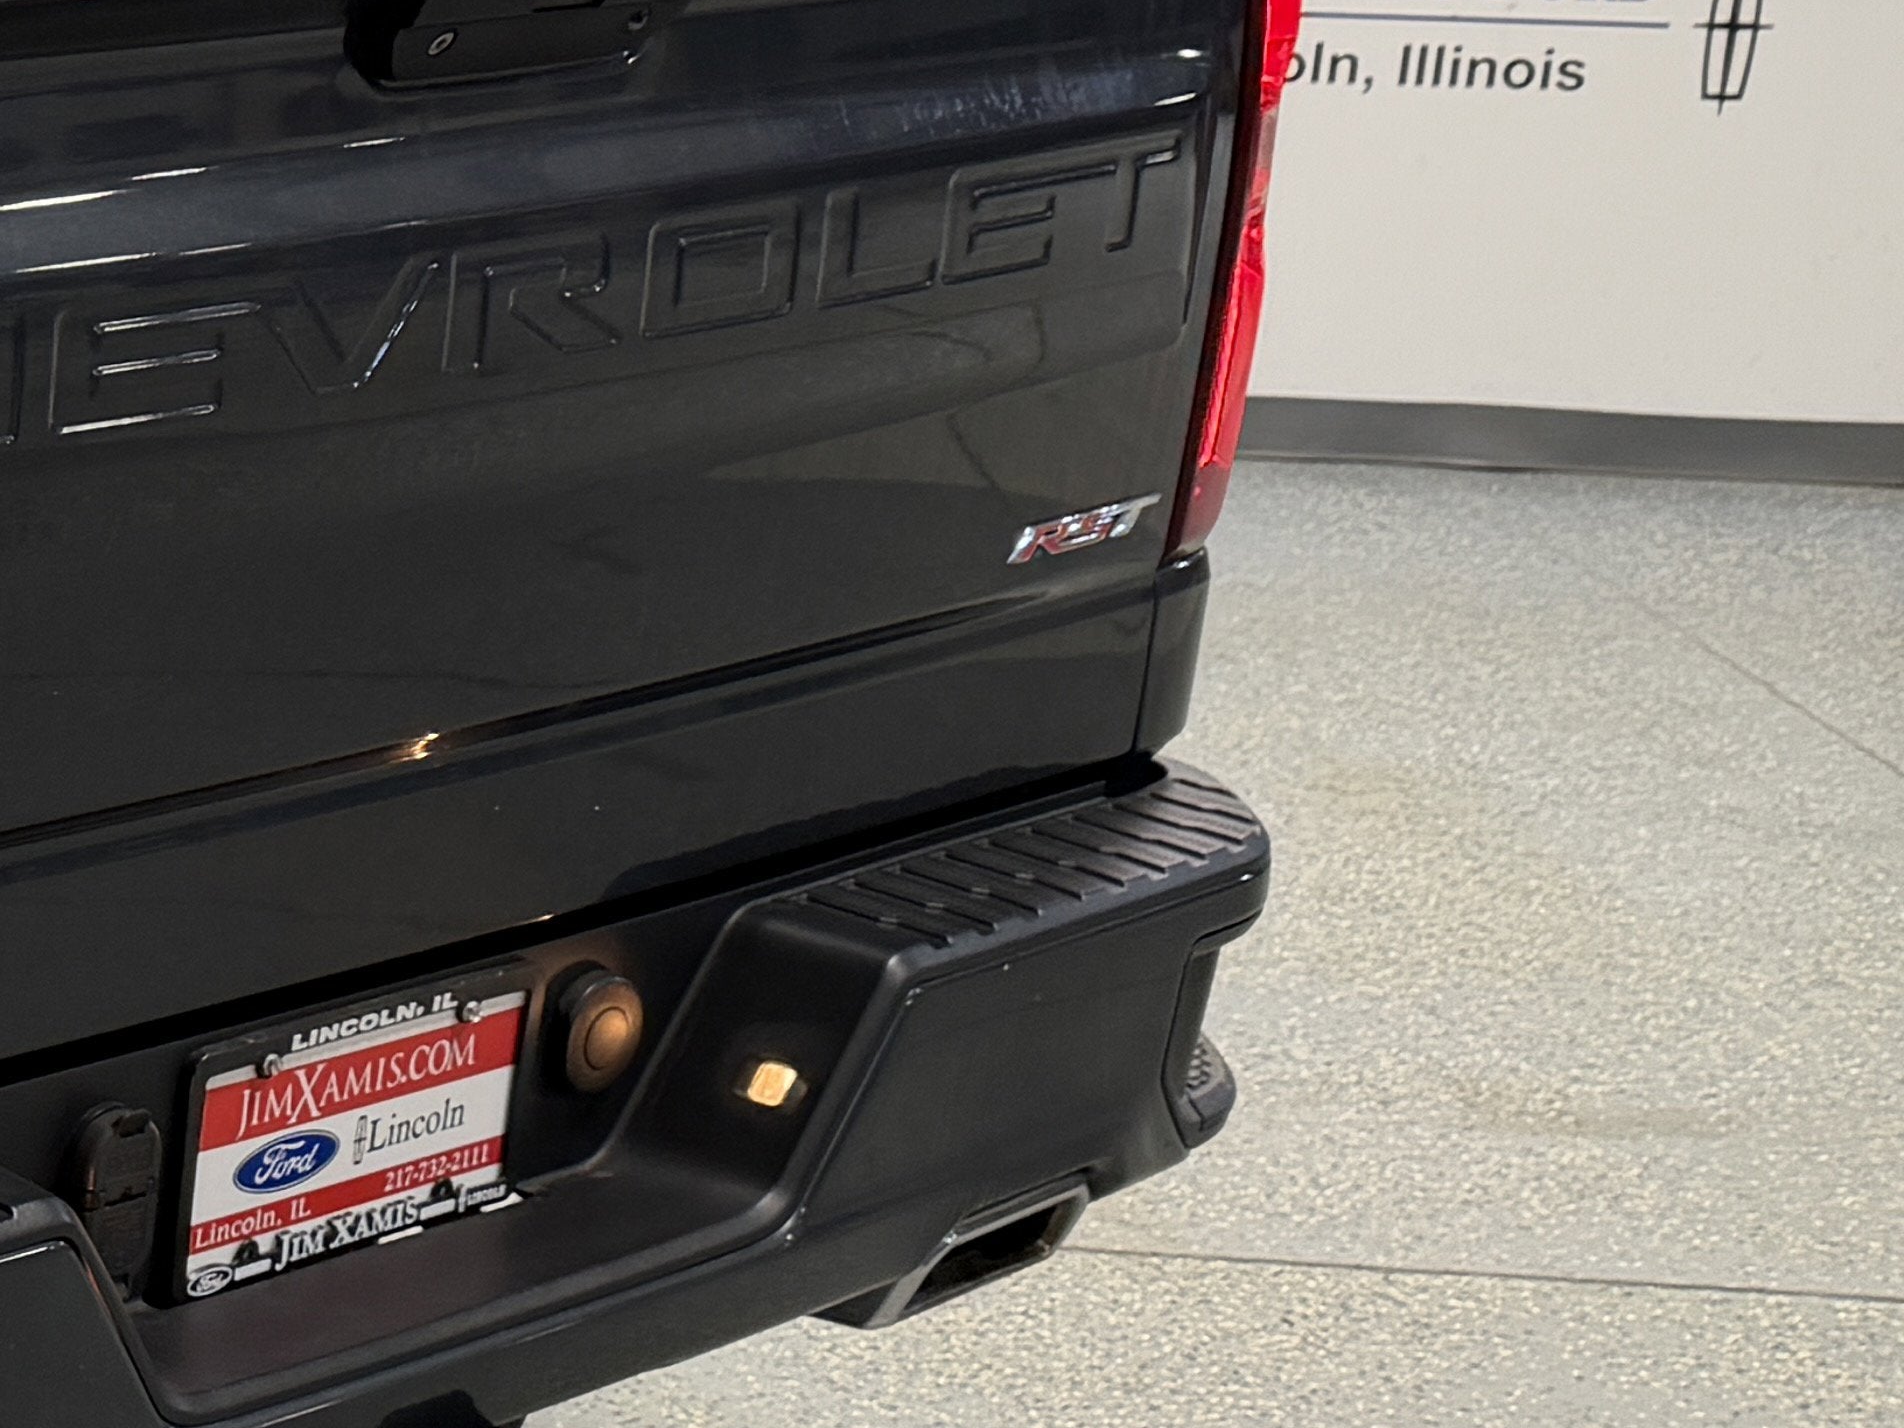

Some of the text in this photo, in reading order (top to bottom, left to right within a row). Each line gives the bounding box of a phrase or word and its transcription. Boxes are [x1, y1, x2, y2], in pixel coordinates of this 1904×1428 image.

[1282, 41, 1587, 95] oln, Illinois
[1006, 491, 1163, 564] RST
[431, 992, 459, 1013] IL
[367, 1098, 465, 1153] Lincoln
[254, 1138, 321, 1186] Ford
[289, 1196, 312, 1221] IL
[274, 1200, 419, 1272] JIM XAMIS
